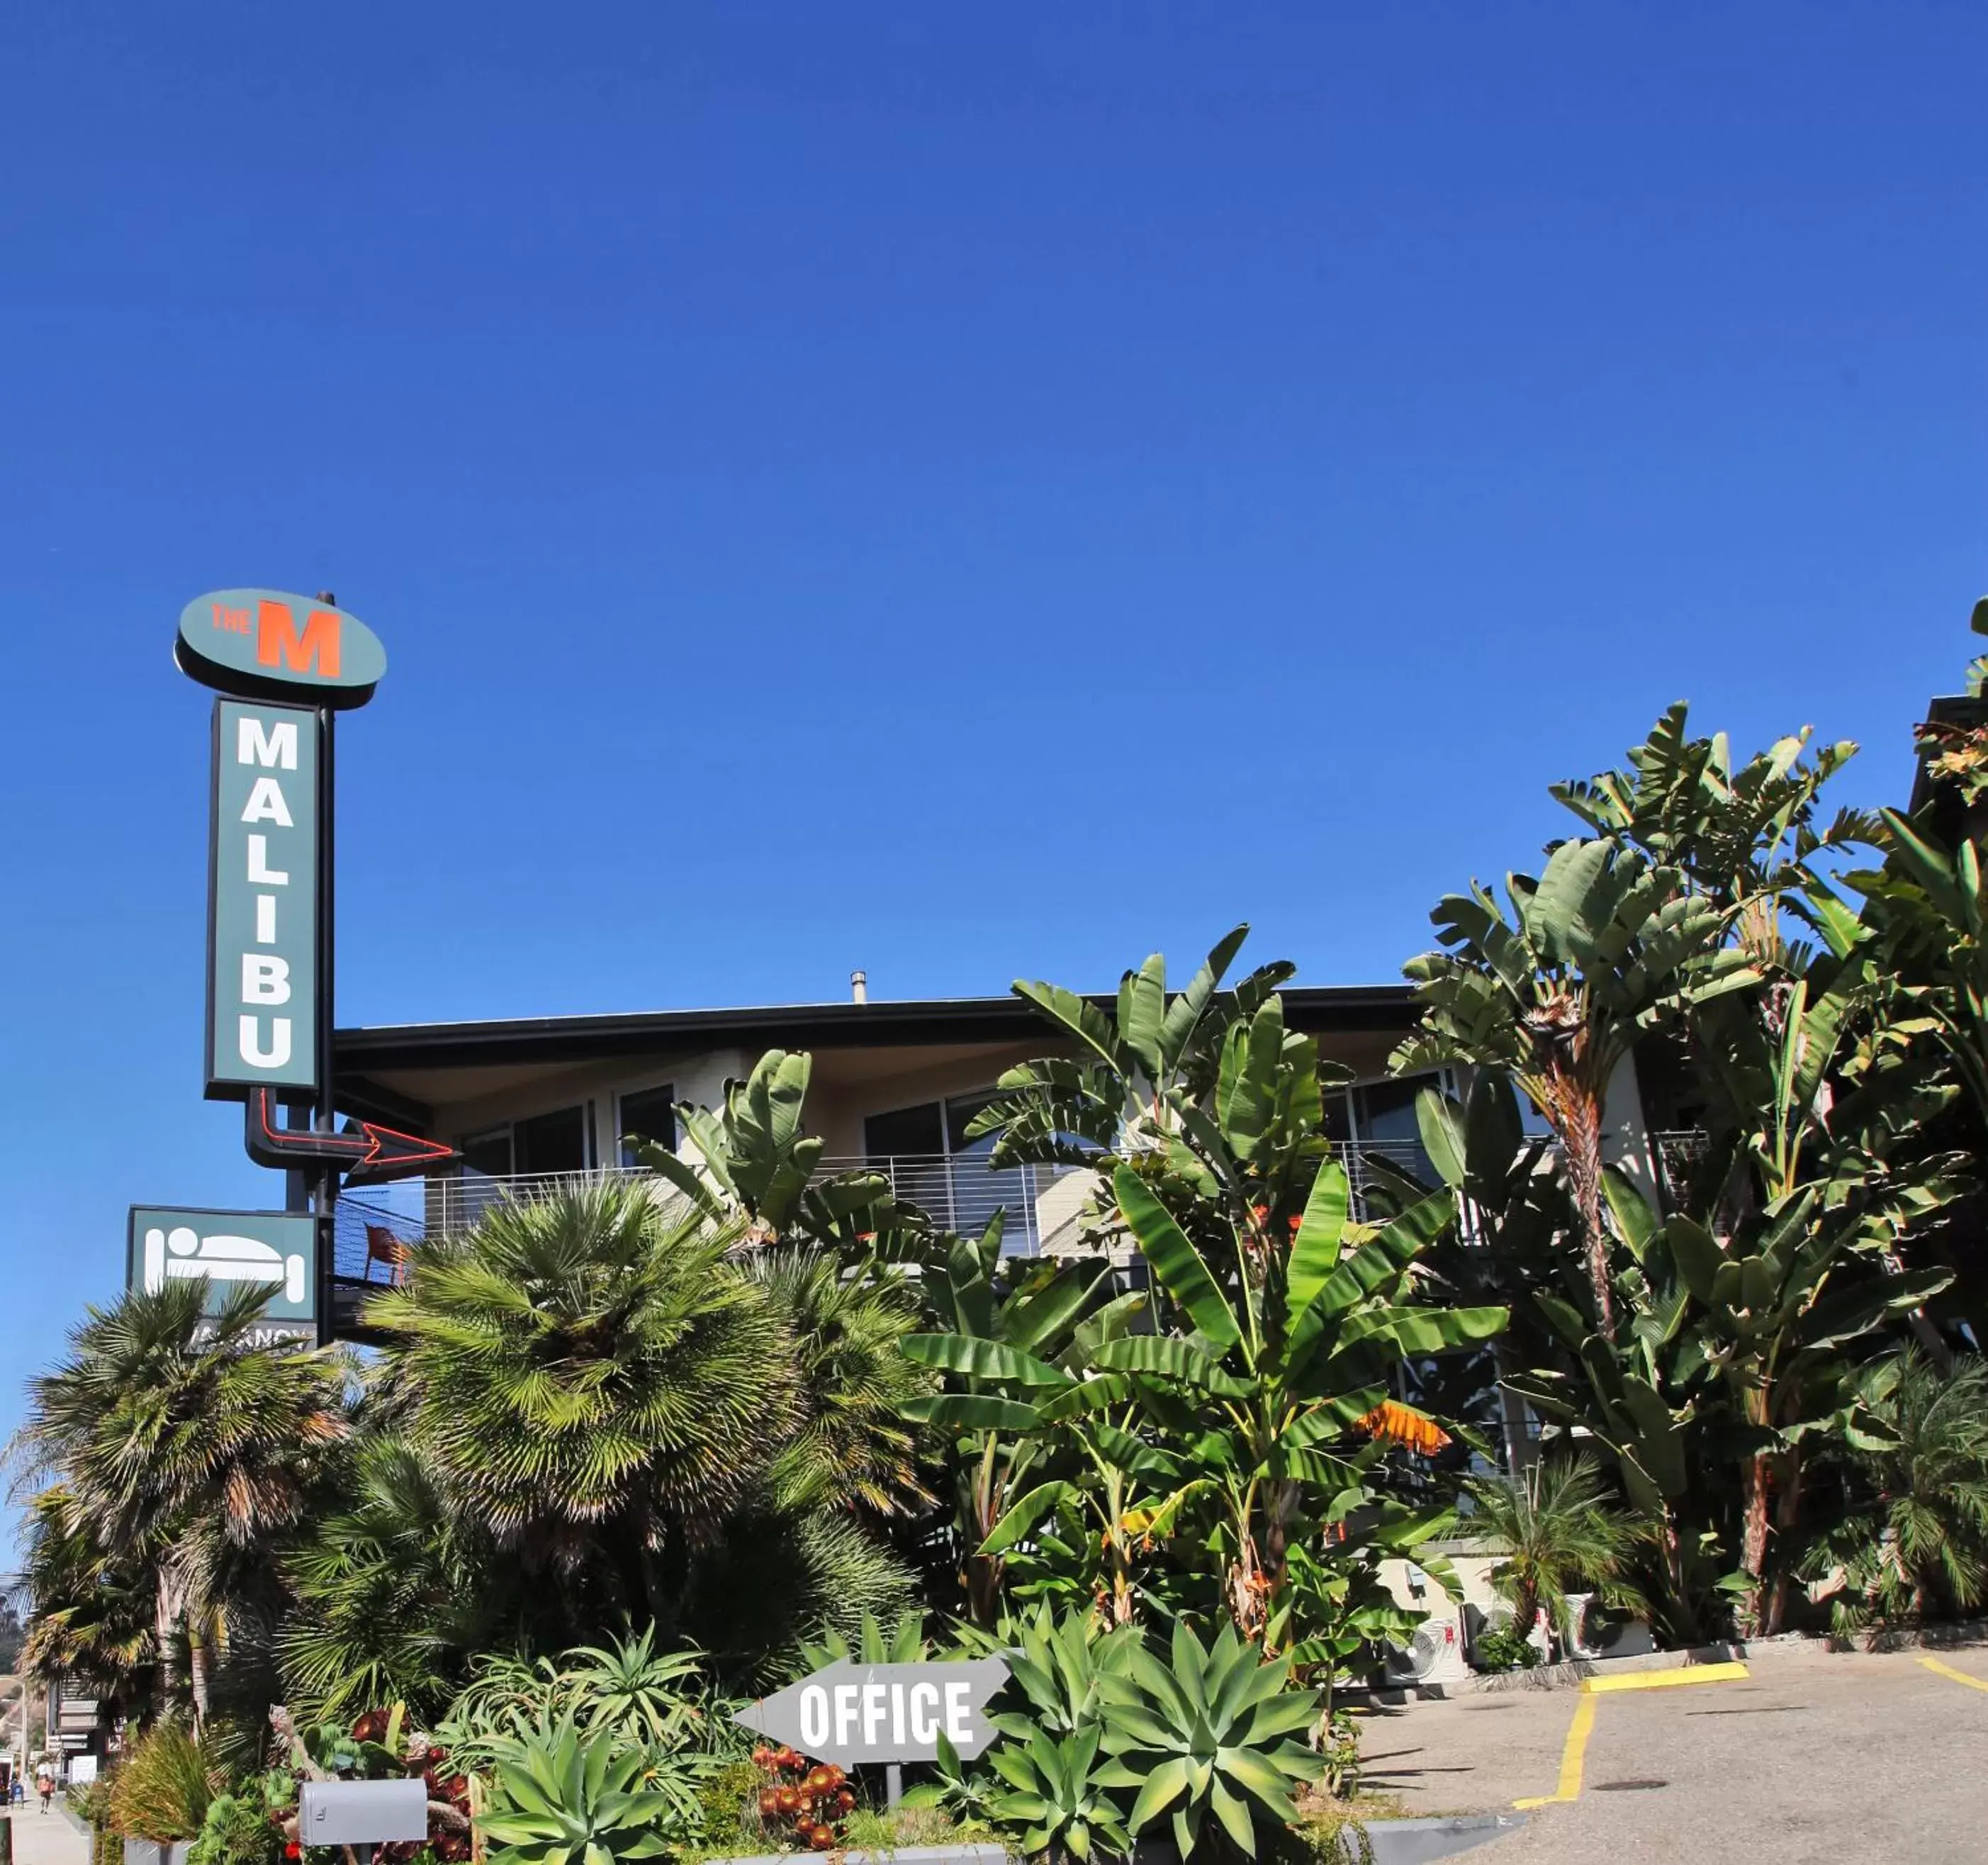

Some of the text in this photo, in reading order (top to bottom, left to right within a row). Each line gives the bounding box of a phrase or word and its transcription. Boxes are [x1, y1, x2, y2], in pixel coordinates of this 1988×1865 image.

[211, 599, 341, 678] THE M
[237, 717, 298, 1068] MALIBU
[799, 1681, 974, 1747] OFFICE
